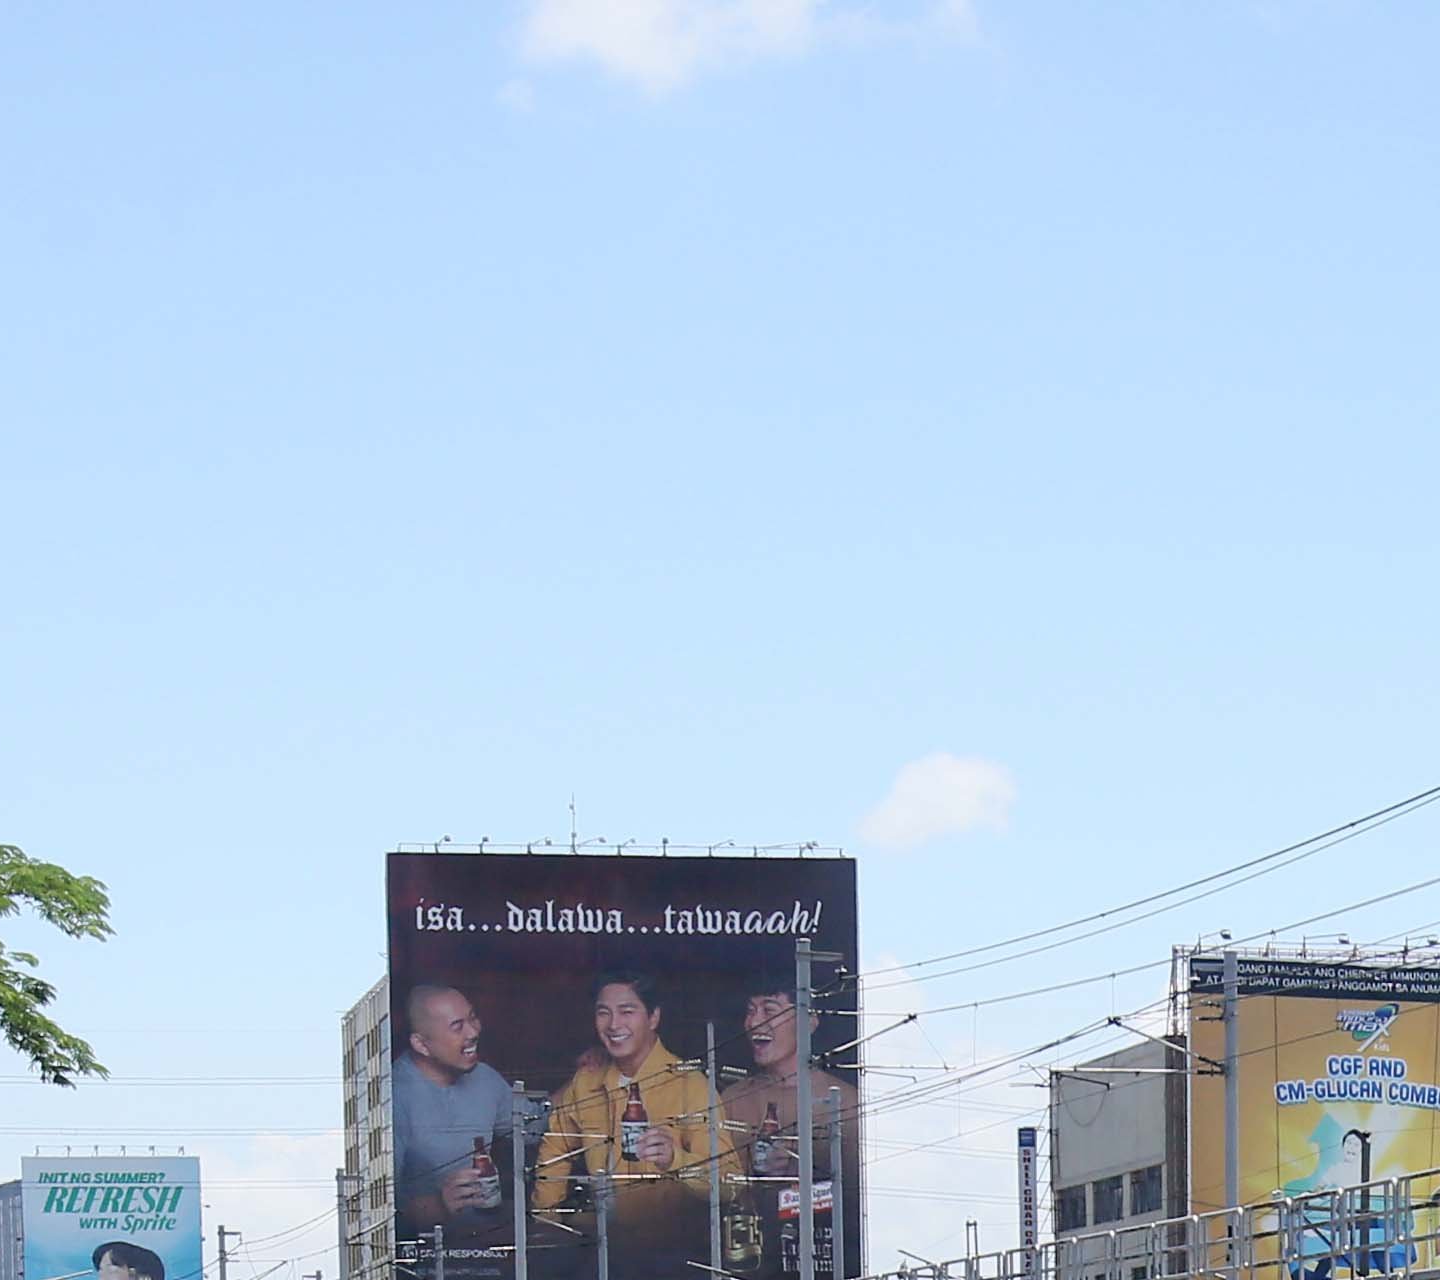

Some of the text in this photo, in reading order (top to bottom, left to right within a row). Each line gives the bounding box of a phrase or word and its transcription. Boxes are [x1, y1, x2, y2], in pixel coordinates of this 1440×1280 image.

[1328, 1056, 1405, 1079] CGF AND
[1275, 1078, 1383, 1103] CM-GLUCAN
[38, 1172, 166, 1184] INIT NG SUMMER?
[43, 1186, 184, 1214] REFRESH
[79, 1213, 177, 1235] WITH Sprite
